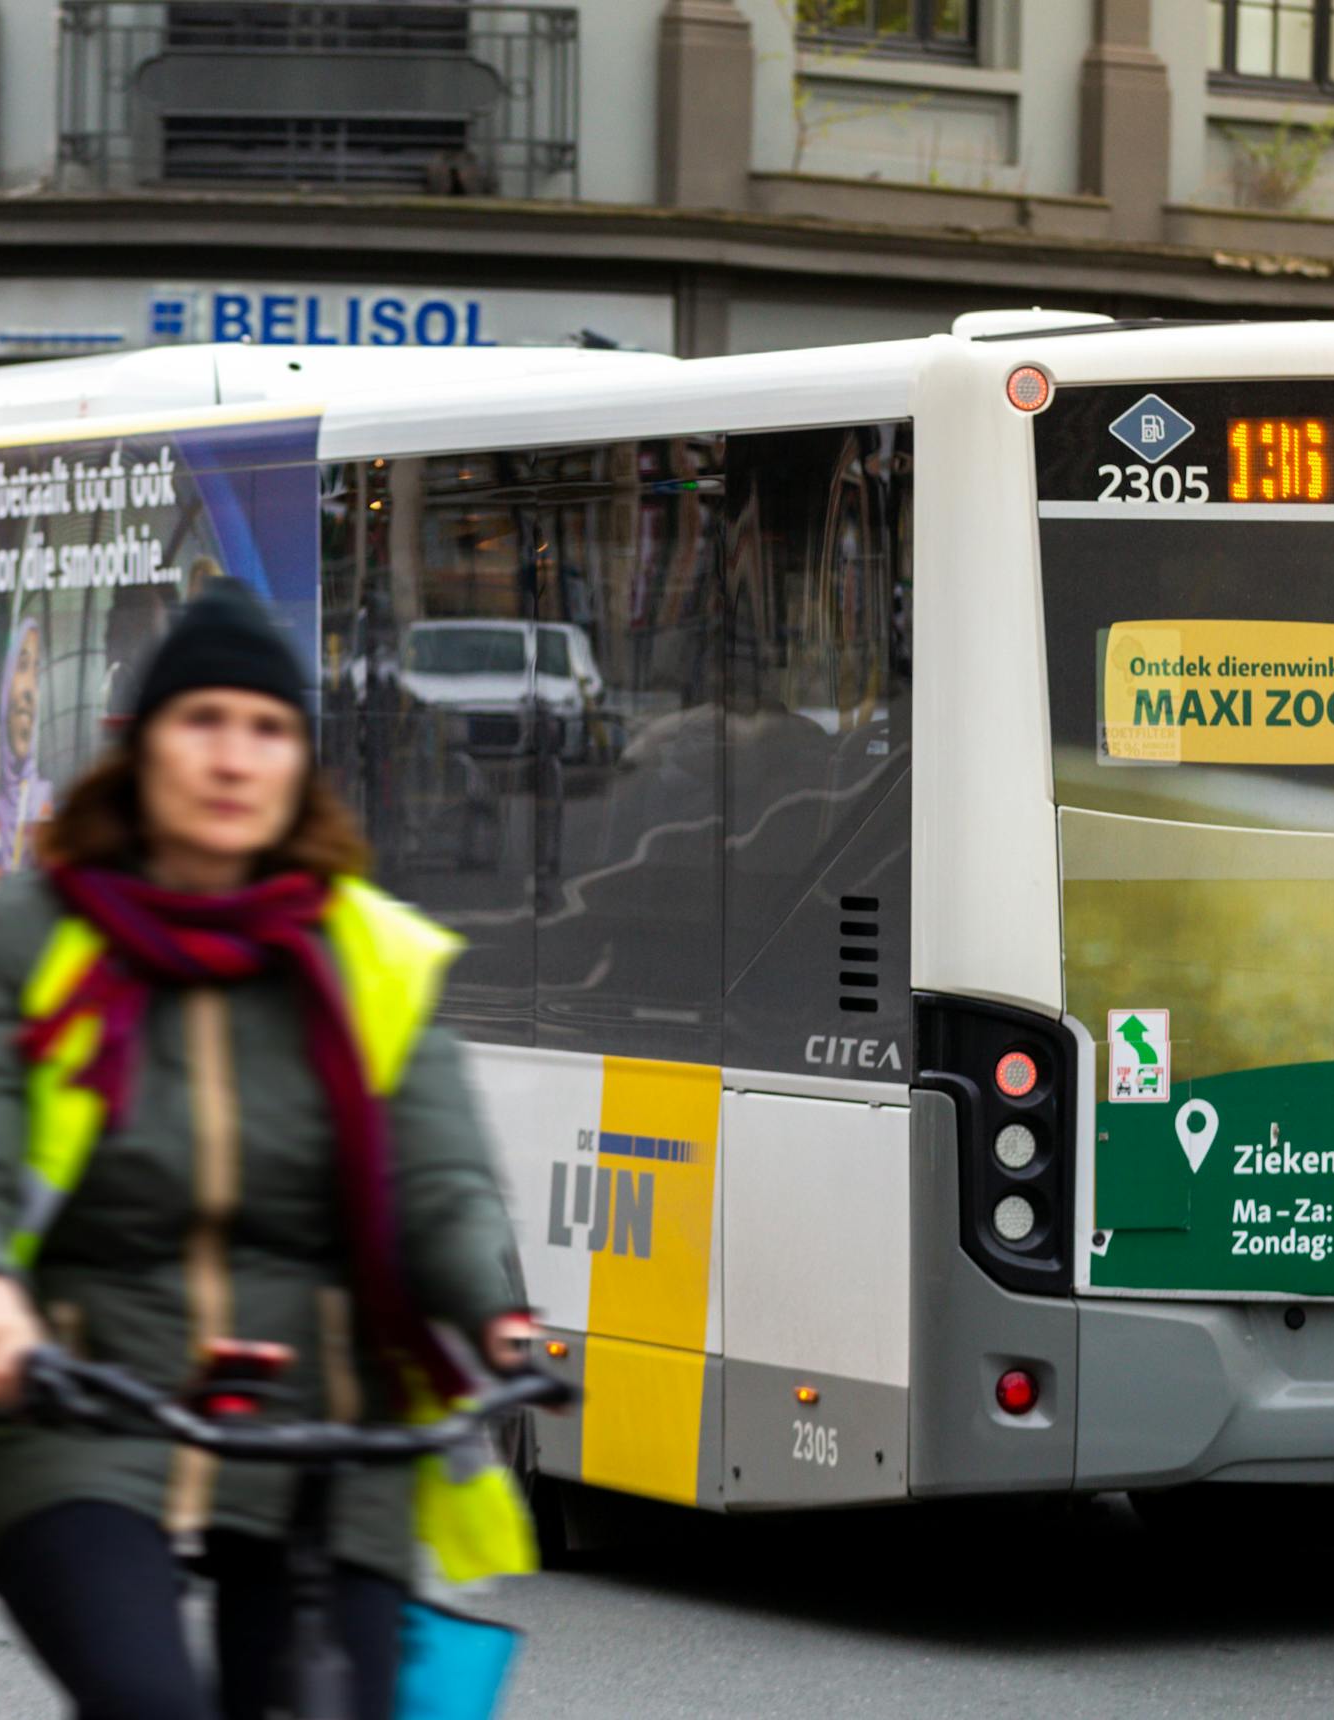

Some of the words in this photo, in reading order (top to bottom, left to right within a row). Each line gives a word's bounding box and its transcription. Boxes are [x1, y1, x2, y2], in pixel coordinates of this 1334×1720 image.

[212, 293, 497, 346] BELISOL
[74, 450, 126, 513] toch
[131, 446, 176, 507] ook
[1098, 464, 1209, 503] 2305
[23, 531, 56, 591] die
[59, 524, 181, 588] smoothie...
[1130, 656, 1211, 678] Ontdek
[1133, 689, 1252, 726] MAXI
[805, 1035, 902, 1070] CITEA
[577, 1129, 595, 1152] DE
[1232, 1199, 1271, 1223] Ma
[1294, 1198, 1333, 1223] Za:
[1232, 1227, 1333, 1261] Zondag:
[792, 1420, 839, 1467] 2305
